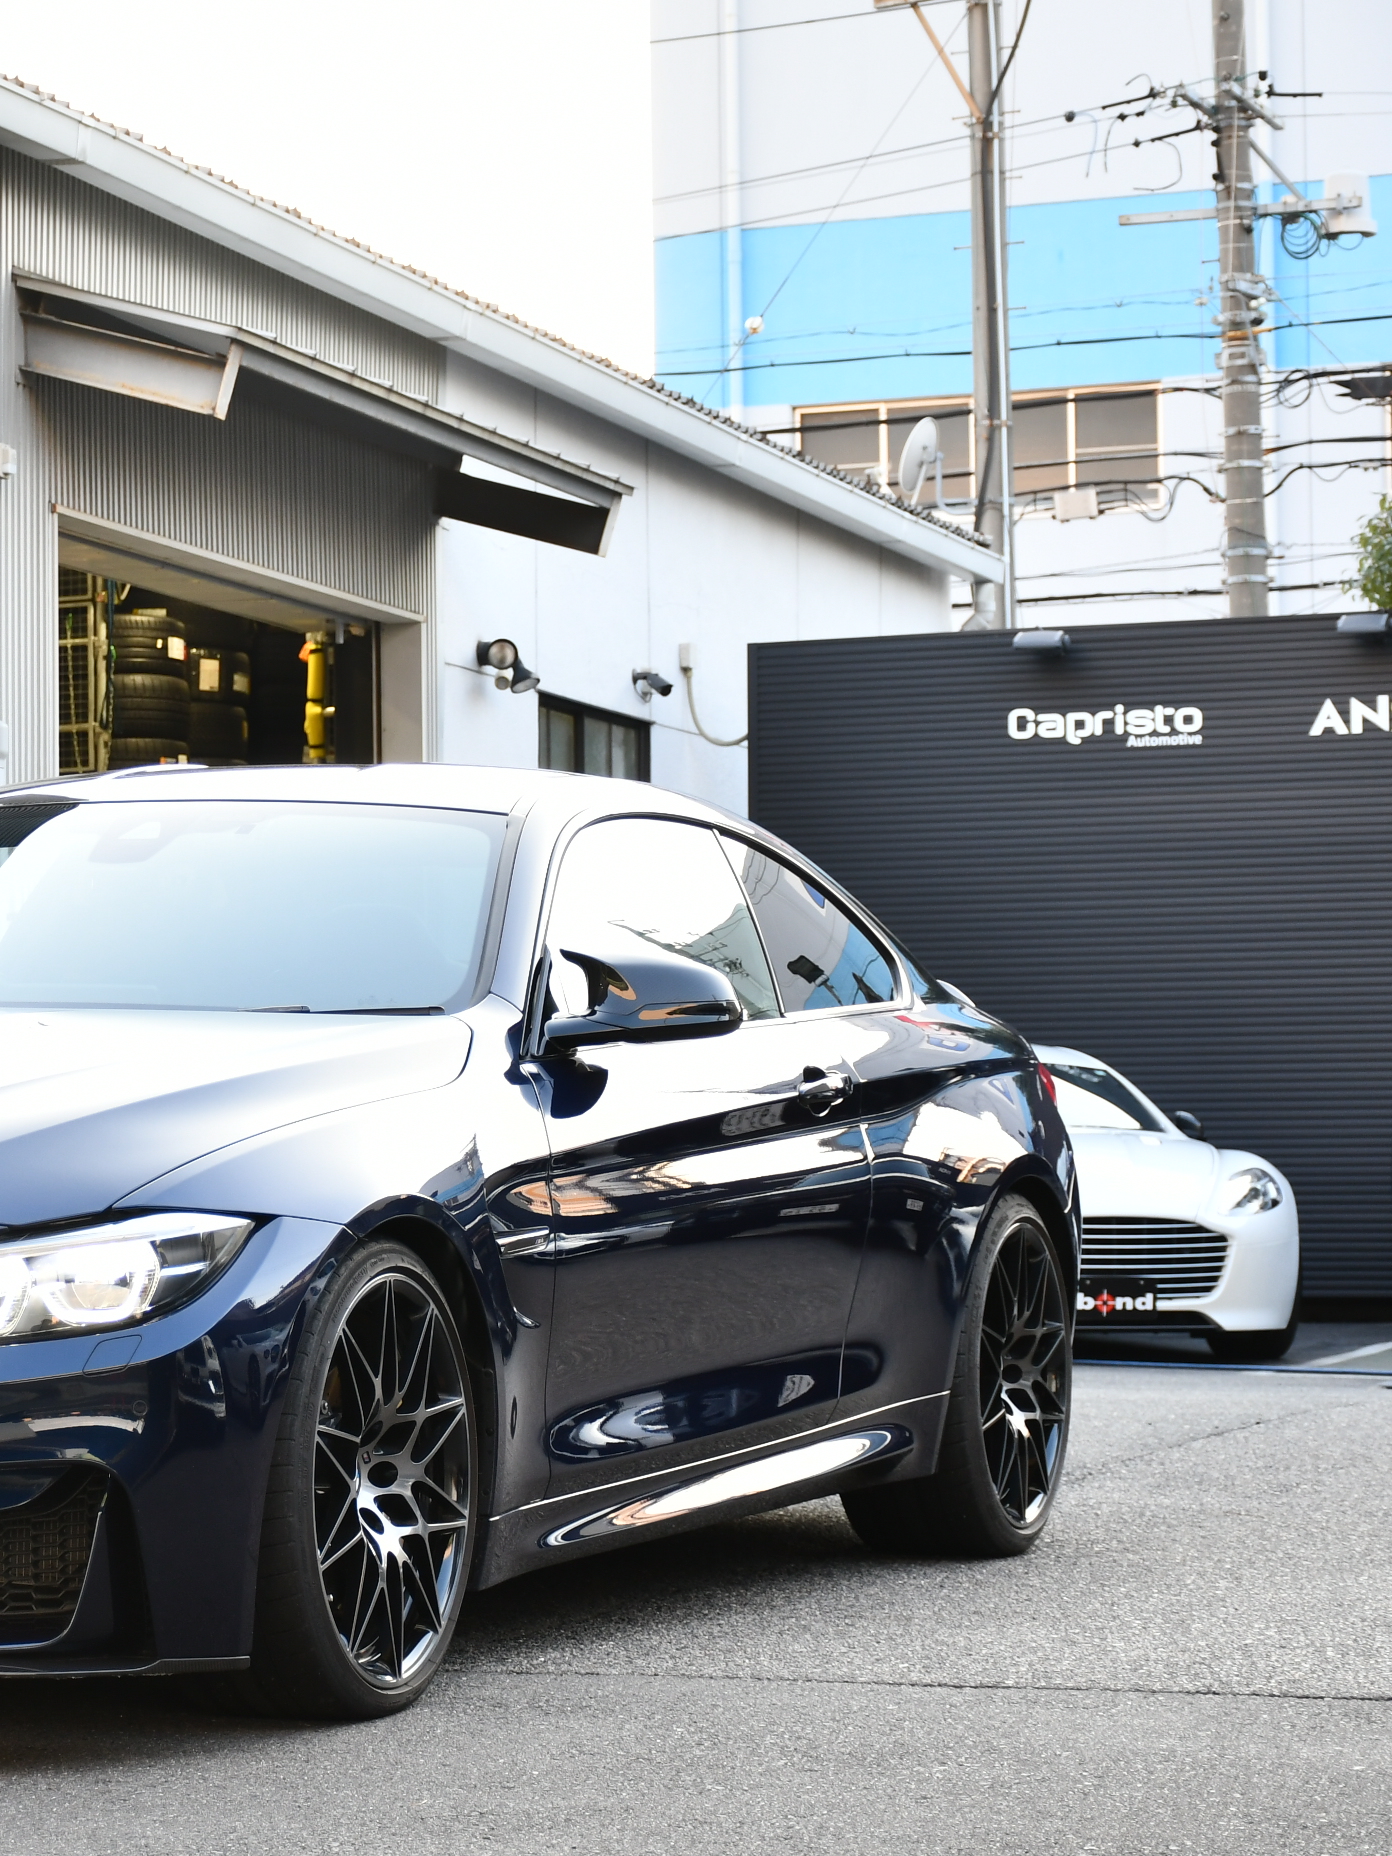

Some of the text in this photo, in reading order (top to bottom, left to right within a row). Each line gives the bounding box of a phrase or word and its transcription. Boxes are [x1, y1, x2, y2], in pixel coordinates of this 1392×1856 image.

[1007, 703, 1204, 745] Capristo
[1308, 694, 1392, 737] AN
[1125, 732, 1204, 748] Automotive
[1076, 1290, 1154, 1315] bond
